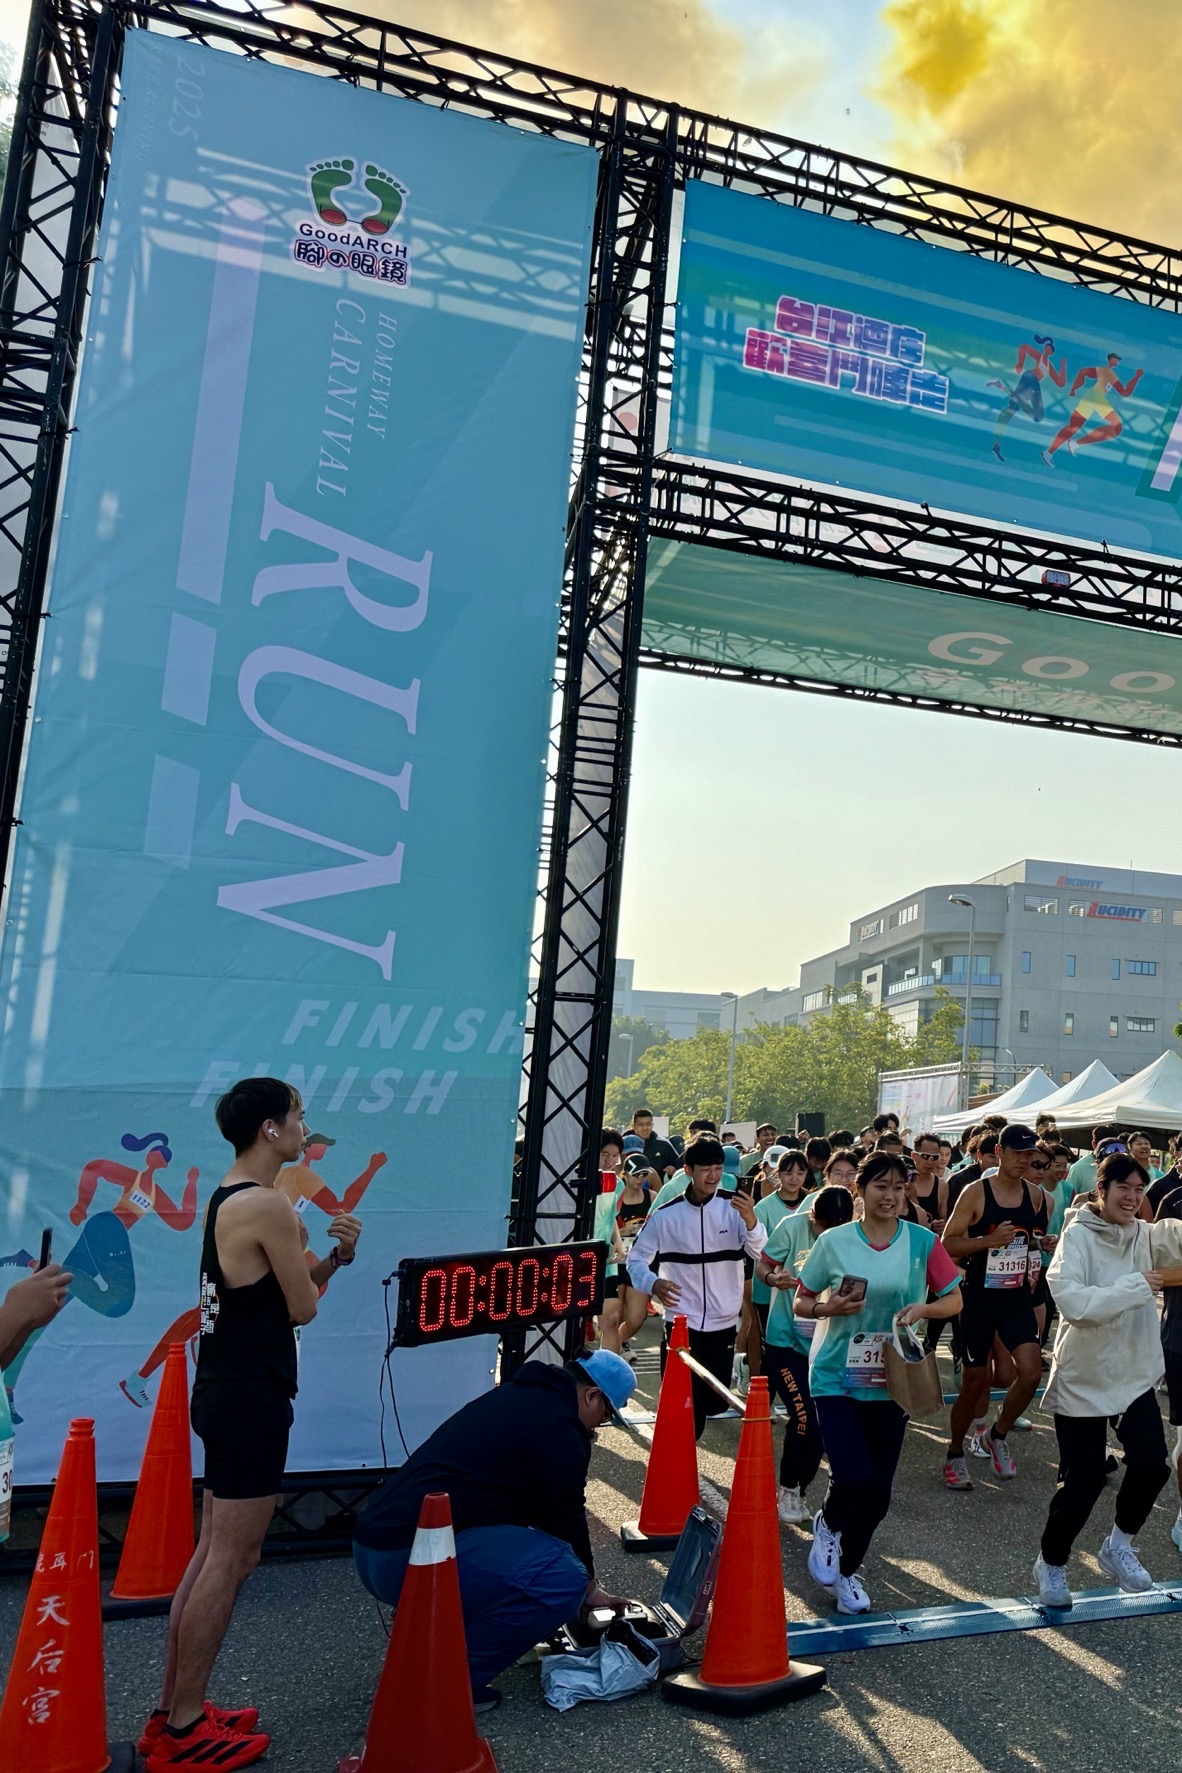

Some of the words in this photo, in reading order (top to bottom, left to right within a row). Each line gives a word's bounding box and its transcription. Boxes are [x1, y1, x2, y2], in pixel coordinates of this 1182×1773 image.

[168, 55, 206, 141] 2025
[295, 240, 407, 285] 腳の眼鏡
[299, 223, 407, 258] GoodARCH
[316, 298, 366, 498] CARNIVAL
[366, 311, 399, 440] HOMEWAY
[216, 481, 434, 981] RUN
[132, 1194, 151, 1209] 1122
[419, 1251, 597, 1332] 00:00:03
[998, 1260, 1026, 1271] 31316
[780, 1367, 799, 1393] NEW
[792, 1392, 807, 1436] TAIPEI
[21, 1594, 71, 1726] 天后宮
